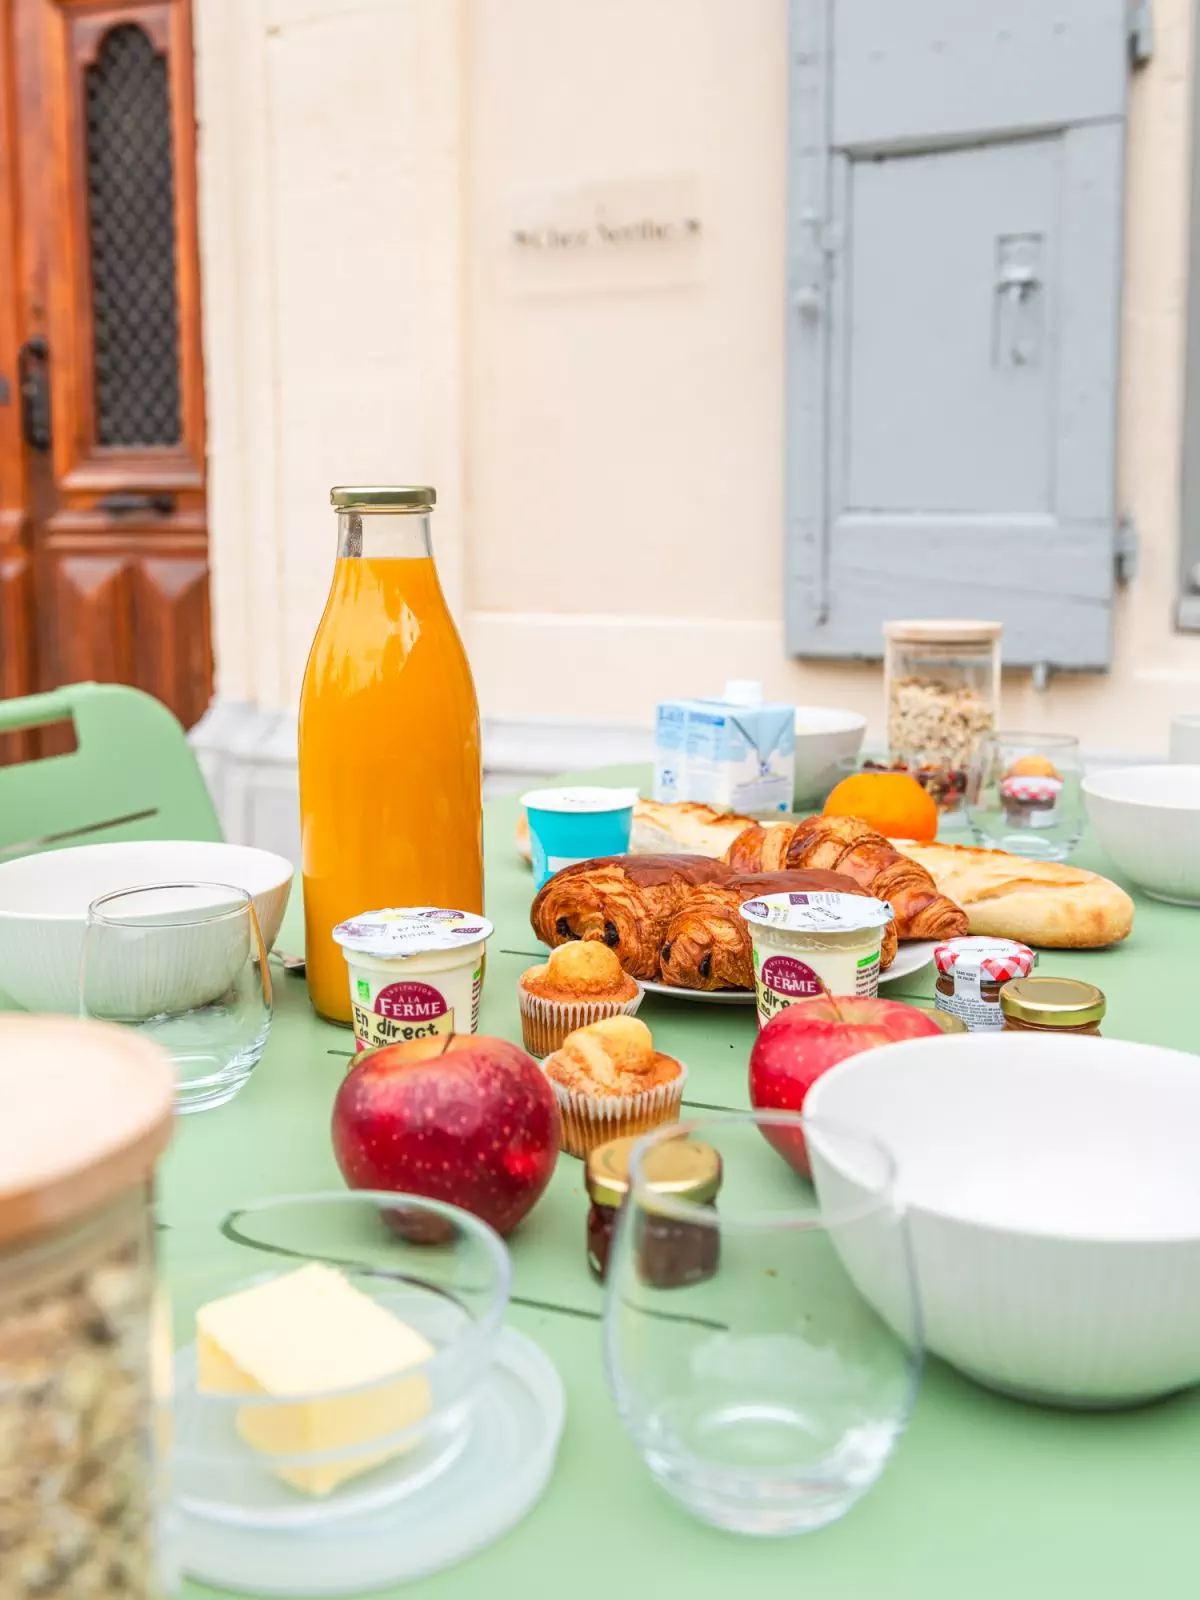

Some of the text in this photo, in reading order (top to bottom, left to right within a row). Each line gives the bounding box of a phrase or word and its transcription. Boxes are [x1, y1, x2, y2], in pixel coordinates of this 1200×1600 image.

[769, 959, 808, 974] INVITATION
[764, 968, 817, 993] FERME
[785, 971, 796, 979] LA
[385, 984, 433, 997] INVITATION
[379, 998, 441, 1017] FERME
[355, 1006, 440, 1040] En direct
[359, 1027, 369, 1039] de
